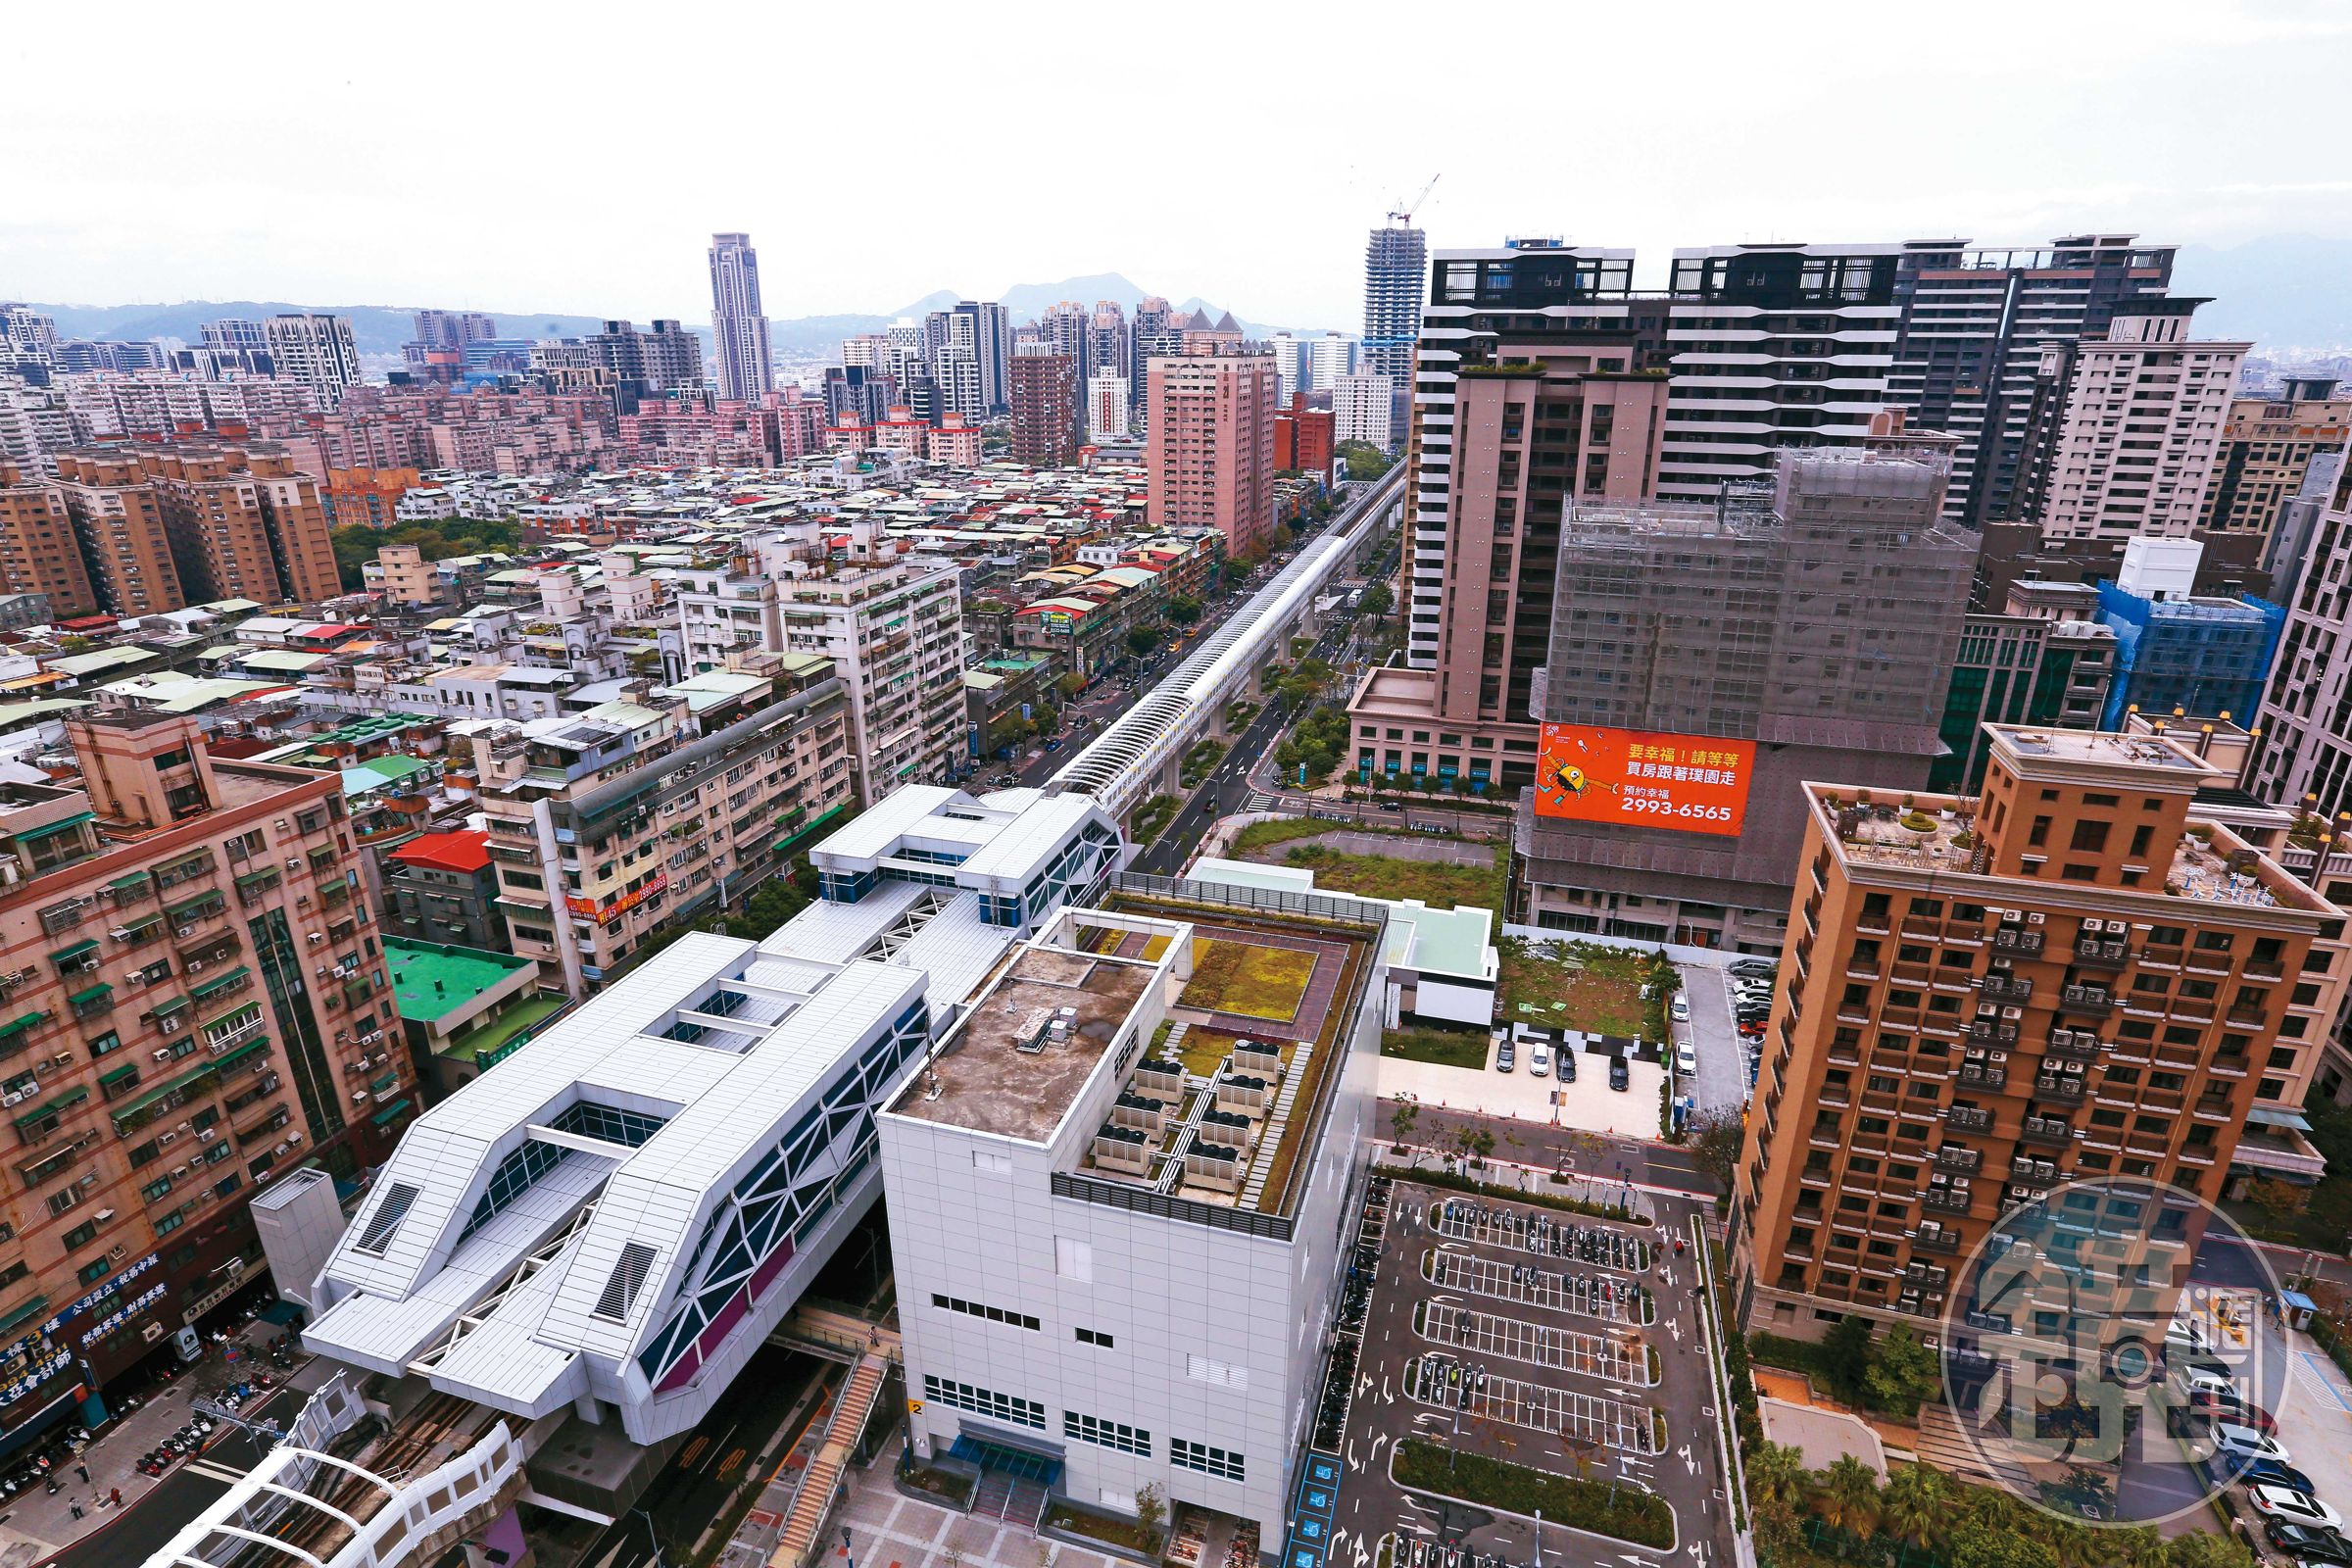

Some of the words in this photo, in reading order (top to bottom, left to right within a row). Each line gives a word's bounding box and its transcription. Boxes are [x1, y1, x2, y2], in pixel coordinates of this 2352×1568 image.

[1628, 743, 1740, 767] 要幸福！請等等
[1626, 761, 1737, 786] 買房跟著璞園走
[1623, 784, 1670, 800] 預約幸福
[1621, 798, 1732, 821] 2993-6565
[0, 1317, 61, 1363] 棟3樓
[913, 1403, 922, 1415] 2
